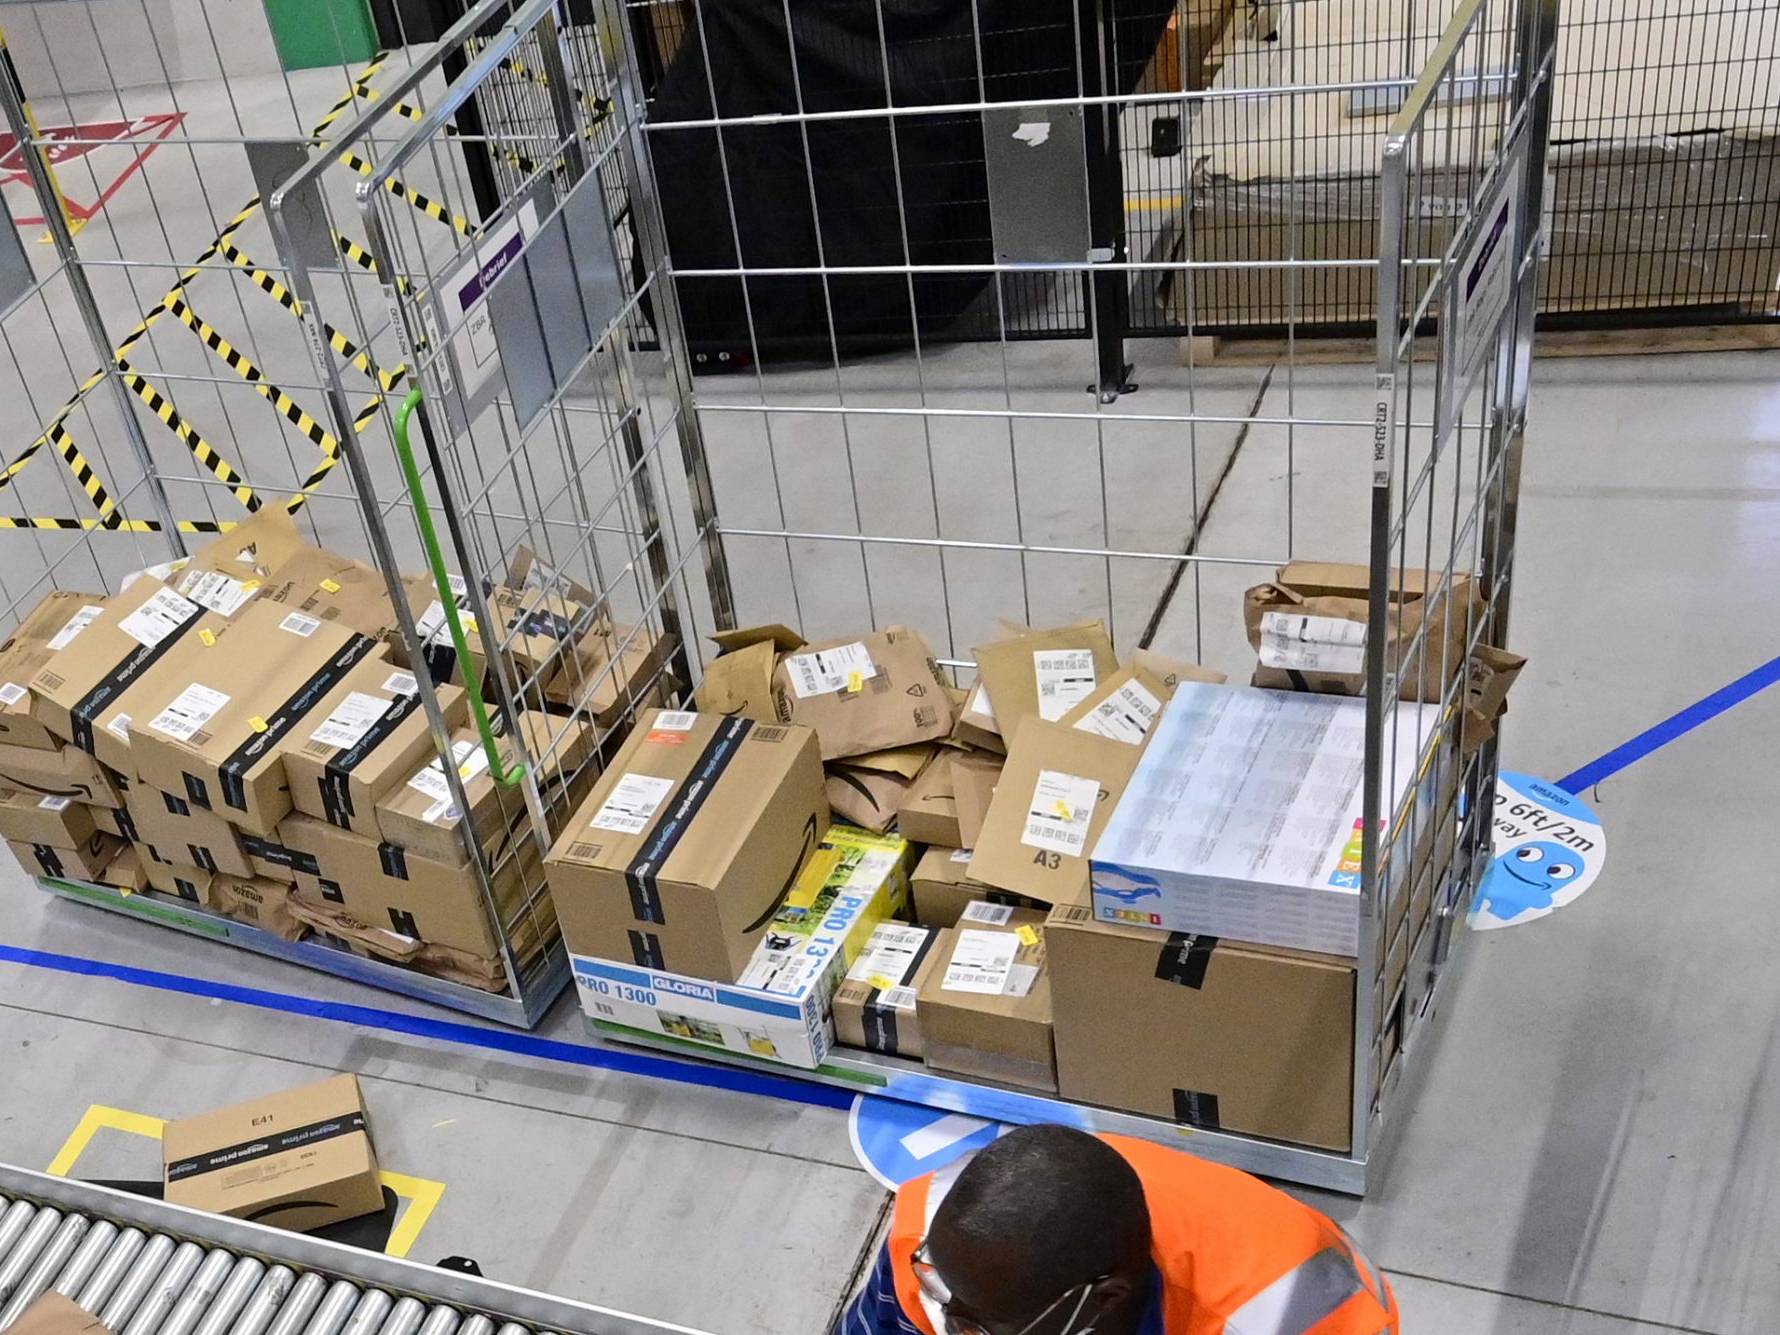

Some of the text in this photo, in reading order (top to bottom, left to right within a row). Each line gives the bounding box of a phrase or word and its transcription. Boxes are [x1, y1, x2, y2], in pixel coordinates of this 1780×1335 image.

[1374, 402, 1388, 461] CRT2-523-DHA
[1509, 803, 1595, 852] 6ft/2m
[1033, 850, 1062, 870] A3
[232, 884, 264, 904] amazon
[823, 895, 862, 932] PRO
[577, 974, 657, 1007] PRO 1300
[653, 976, 714, 1001] GLORIA
[251, 1114, 274, 1127] E41
